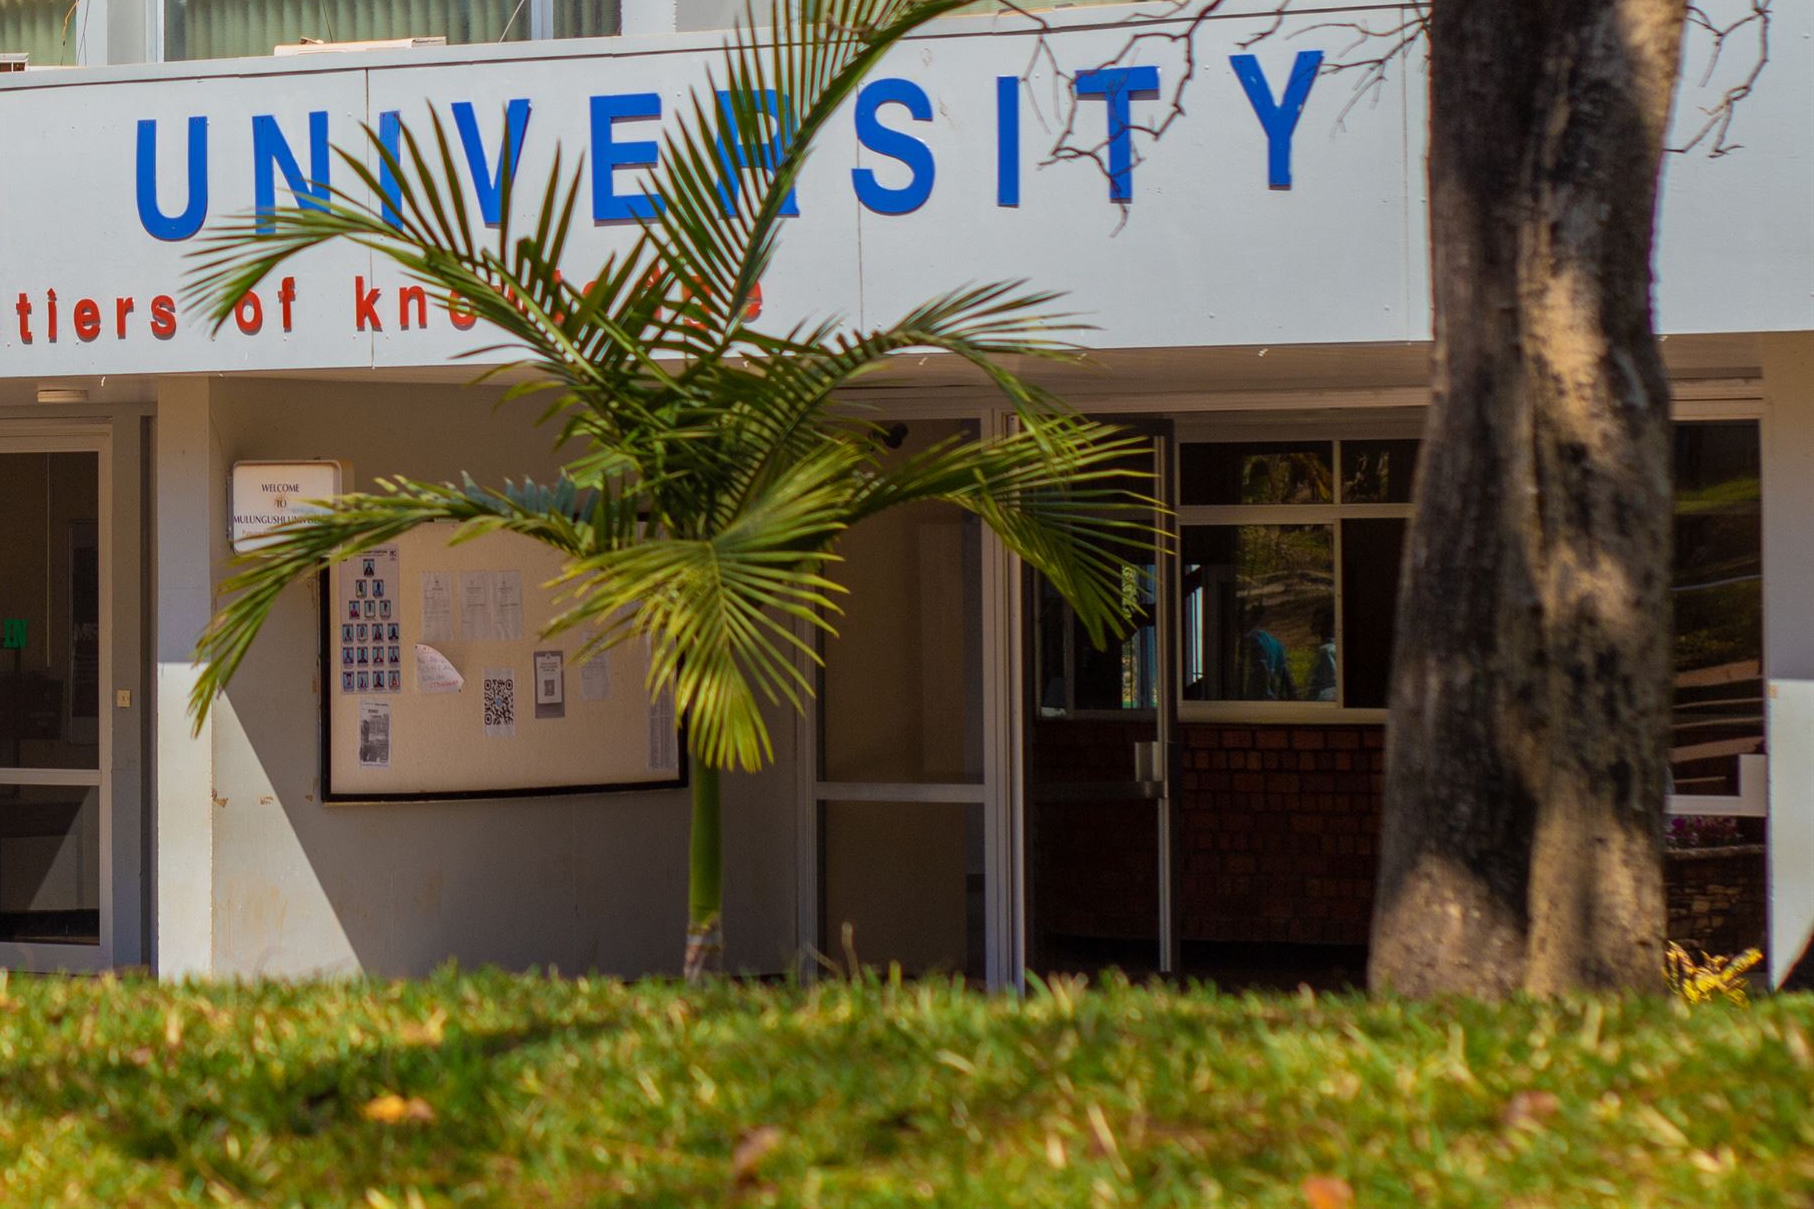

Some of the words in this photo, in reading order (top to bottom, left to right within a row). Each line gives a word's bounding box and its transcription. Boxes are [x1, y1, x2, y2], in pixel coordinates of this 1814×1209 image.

[136, 50, 1324, 242] UNIVERSITY
[234, 275, 296, 334] of
[261, 484, 300, 492] WELCOME
[275, 500, 287, 508] TO
[233, 515, 286, 524] MULUNGUSHI
